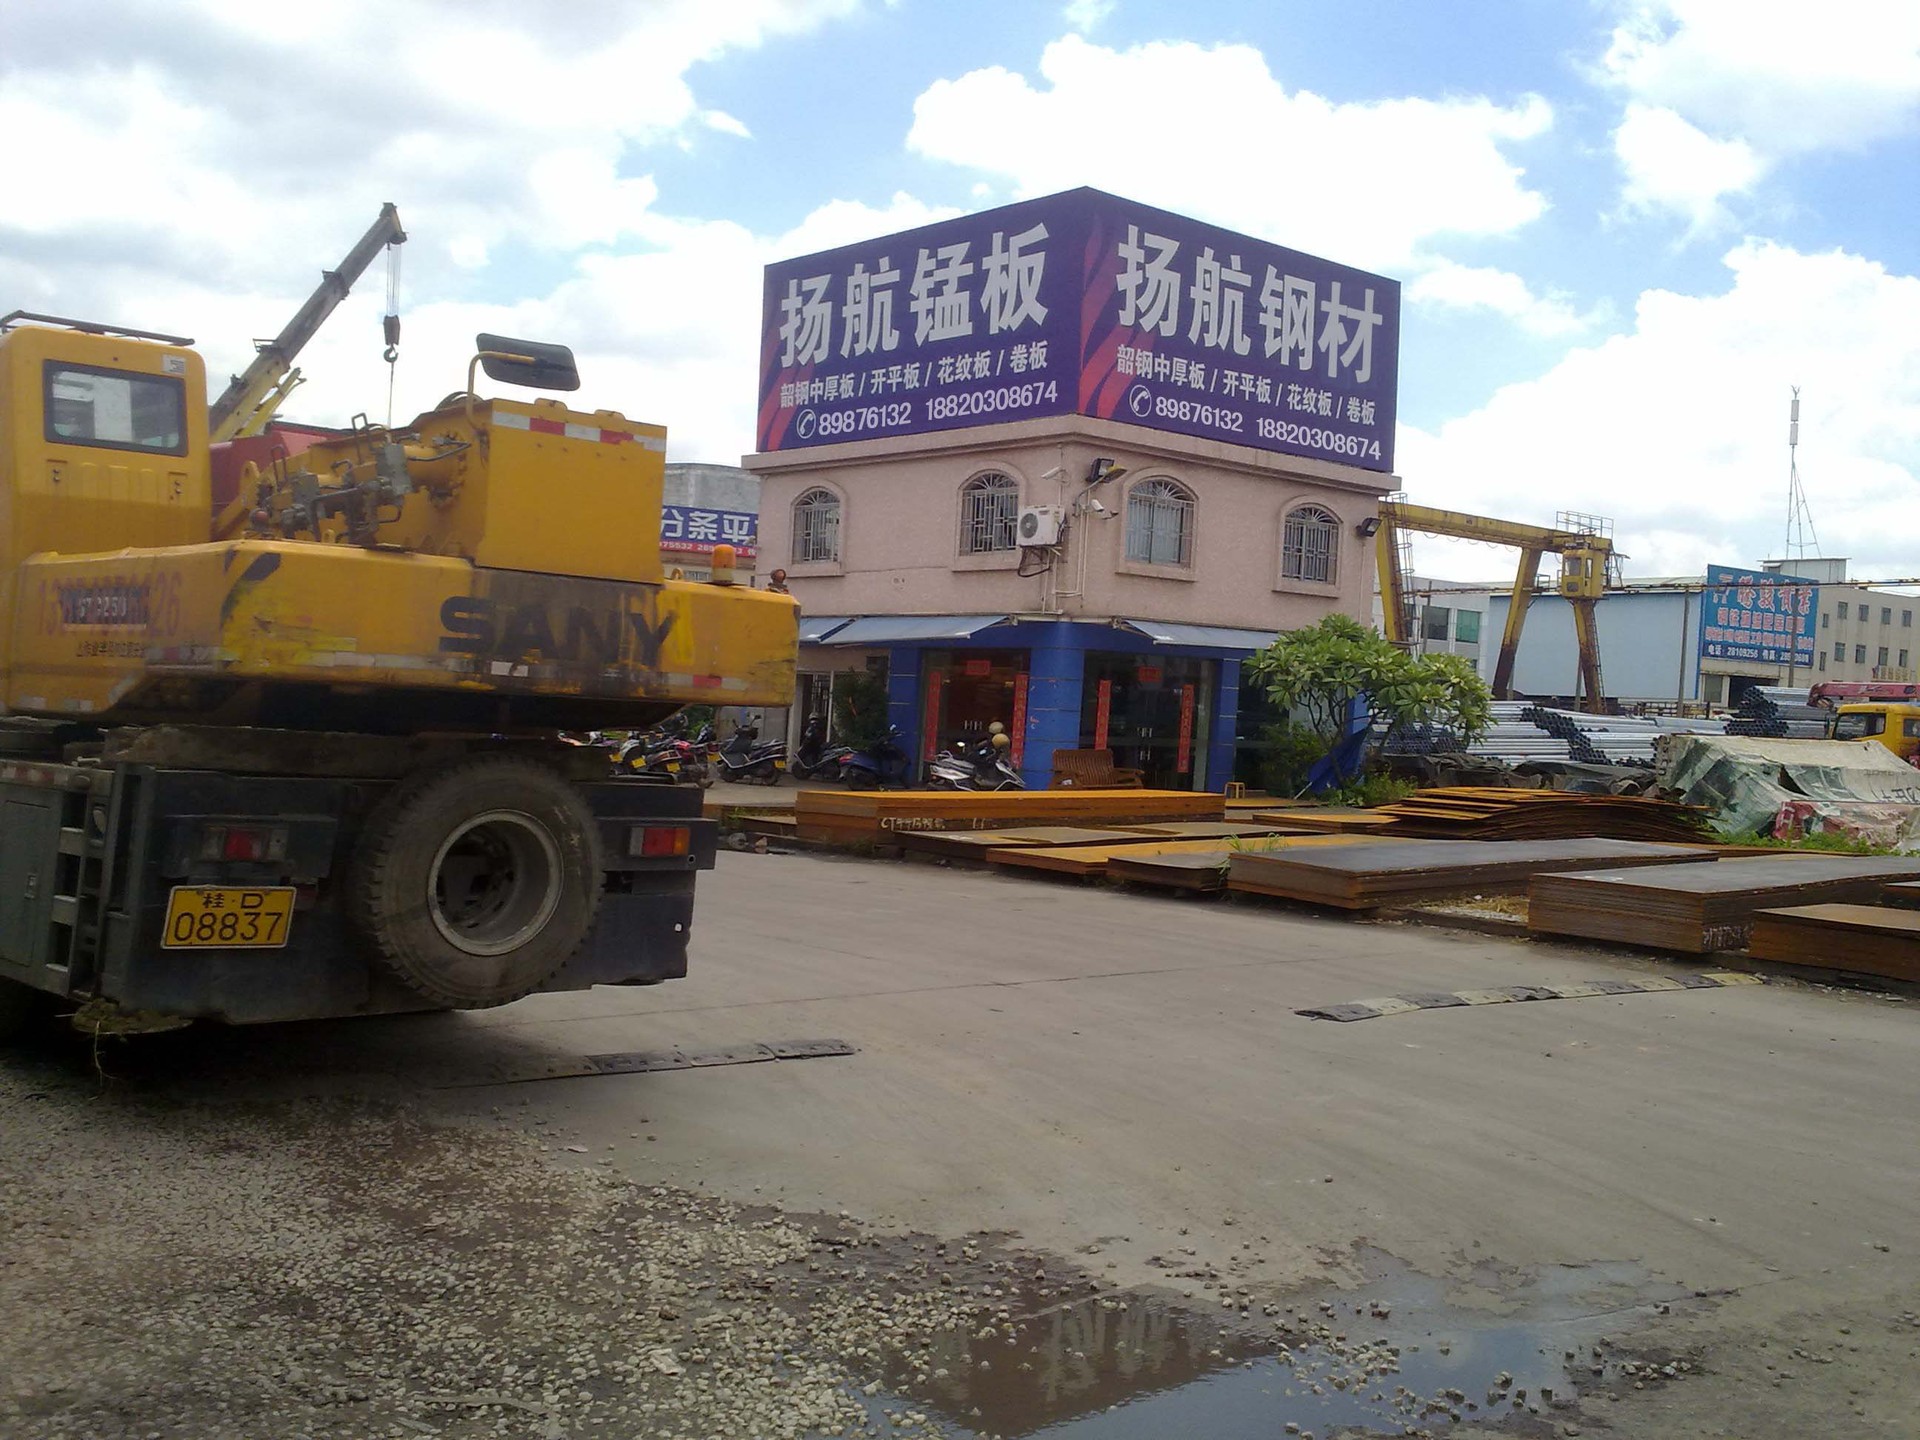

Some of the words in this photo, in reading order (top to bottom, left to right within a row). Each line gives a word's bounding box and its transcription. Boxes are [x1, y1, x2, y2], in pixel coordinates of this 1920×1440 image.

[779, 222, 1049, 368] 扬航锰板
[1116, 224, 1383, 383] 扬航钢材
[818, 402, 912, 436] 89876132
[926, 380, 1058, 421] 18820308674
[1155, 396, 1243, 433] 89876132
[1256, 417, 1382, 461] 18820308674
[439, 595, 677, 667] SANY
[174, 912, 283, 941] 08837
